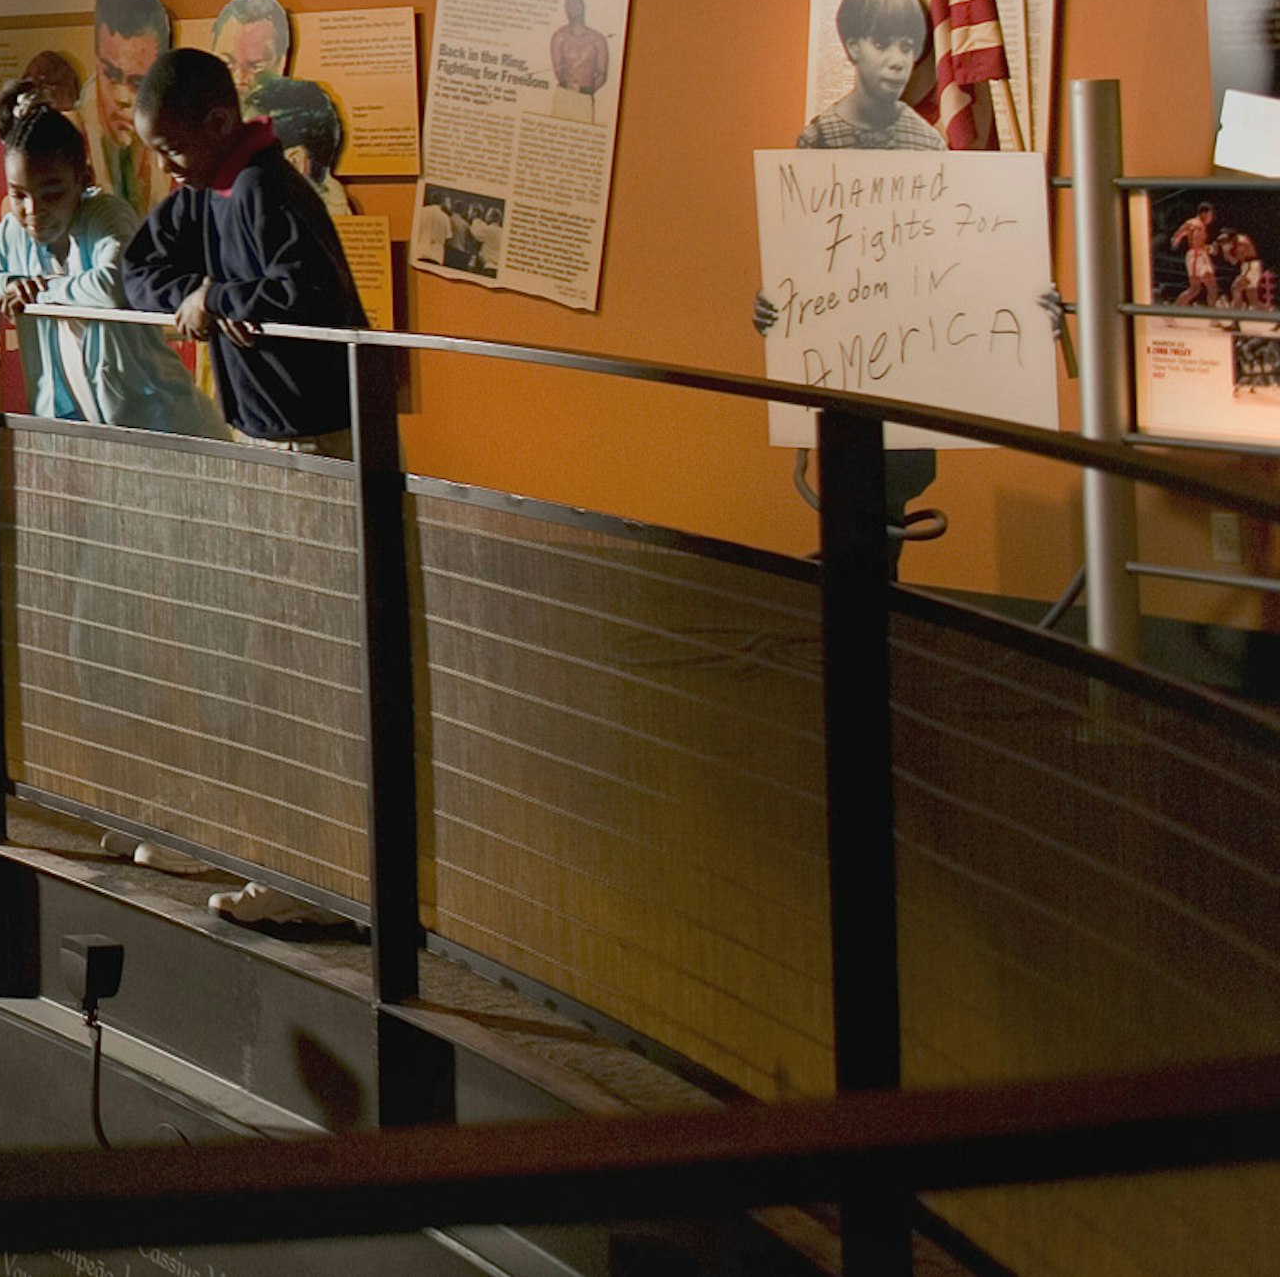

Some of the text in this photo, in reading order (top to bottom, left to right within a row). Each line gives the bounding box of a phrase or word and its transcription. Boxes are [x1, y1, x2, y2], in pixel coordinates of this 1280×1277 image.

[440, 43, 529, 72] Back in the Ring,
[437, 58, 549, 90] Fighting for Freedom
[825, 209, 935, 272] Fights
